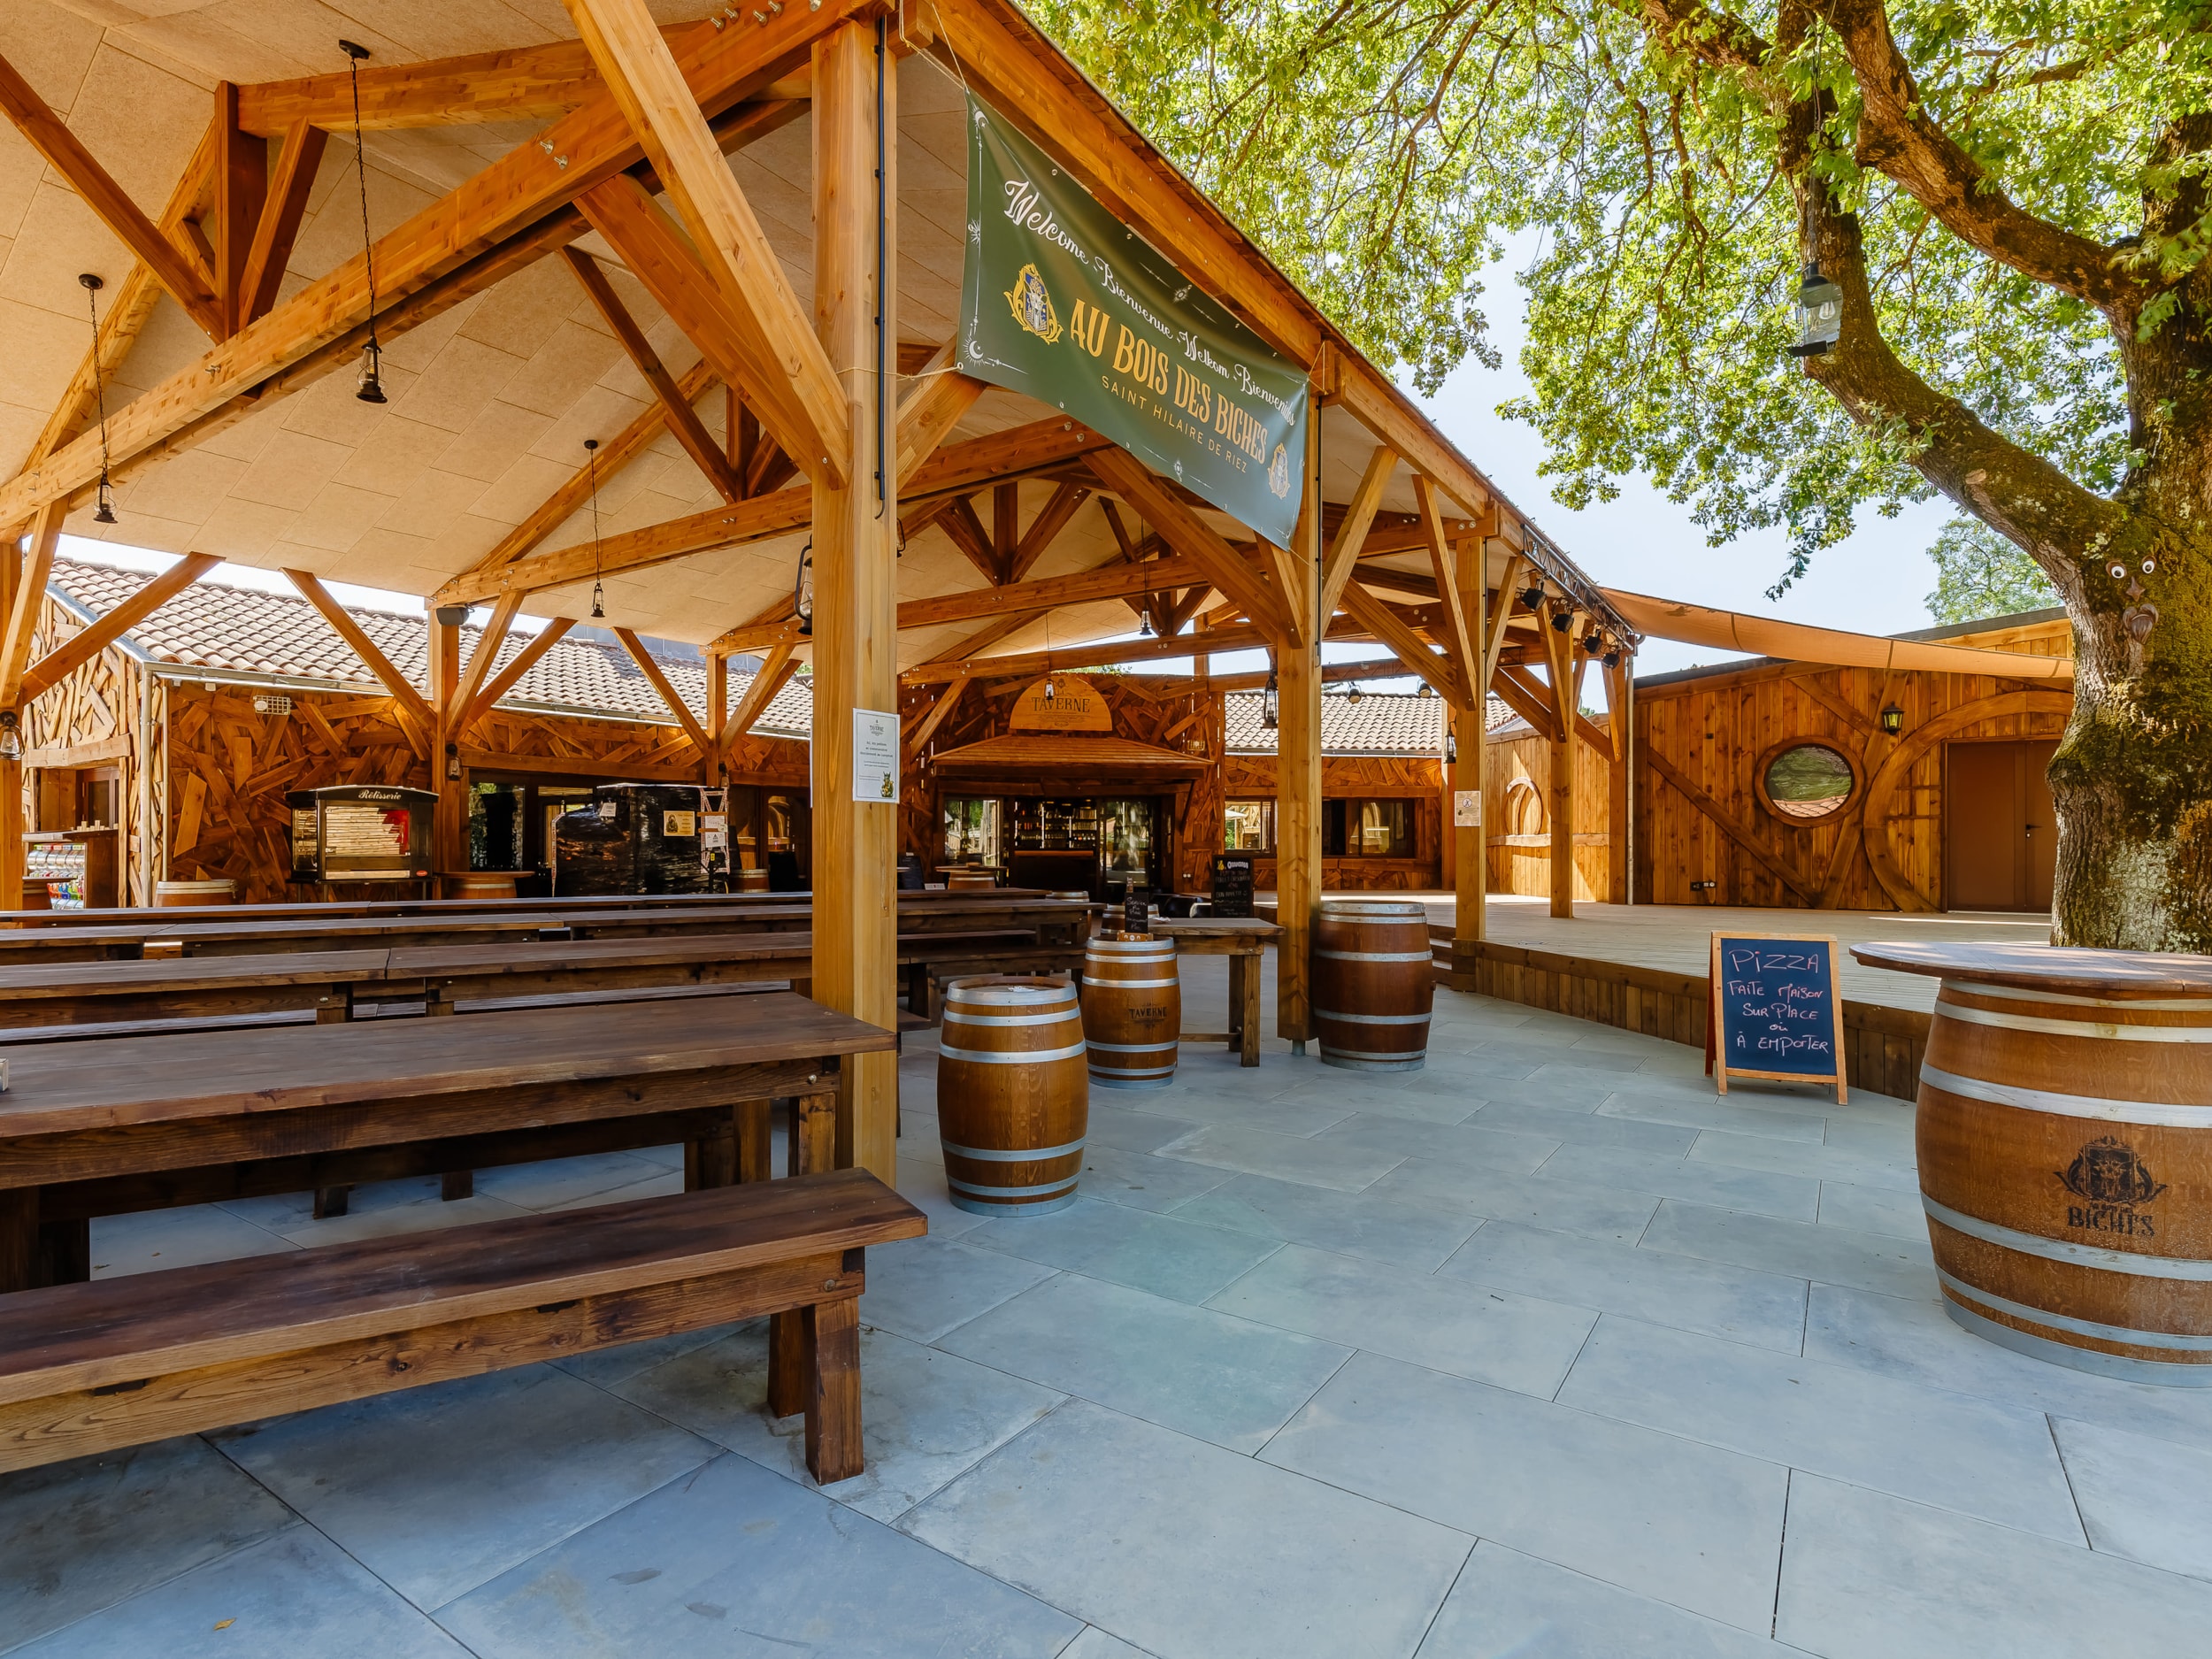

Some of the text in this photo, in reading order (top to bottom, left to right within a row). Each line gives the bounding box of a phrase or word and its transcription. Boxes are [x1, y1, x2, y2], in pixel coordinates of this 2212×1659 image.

[1004, 180, 1089, 265] Welcome
[1094, 256, 1173, 340] Bienvenue
[1179, 330, 1230, 380] Welkom
[1070, 297, 1268, 465] AU BOIS DES BICHES
[1102, 375, 1248, 473] SAINT HILAIRE DE RIEZ
[1032, 697, 1091, 713] TAVERNE
[1128, 1006, 1168, 1019] TAVERNE
